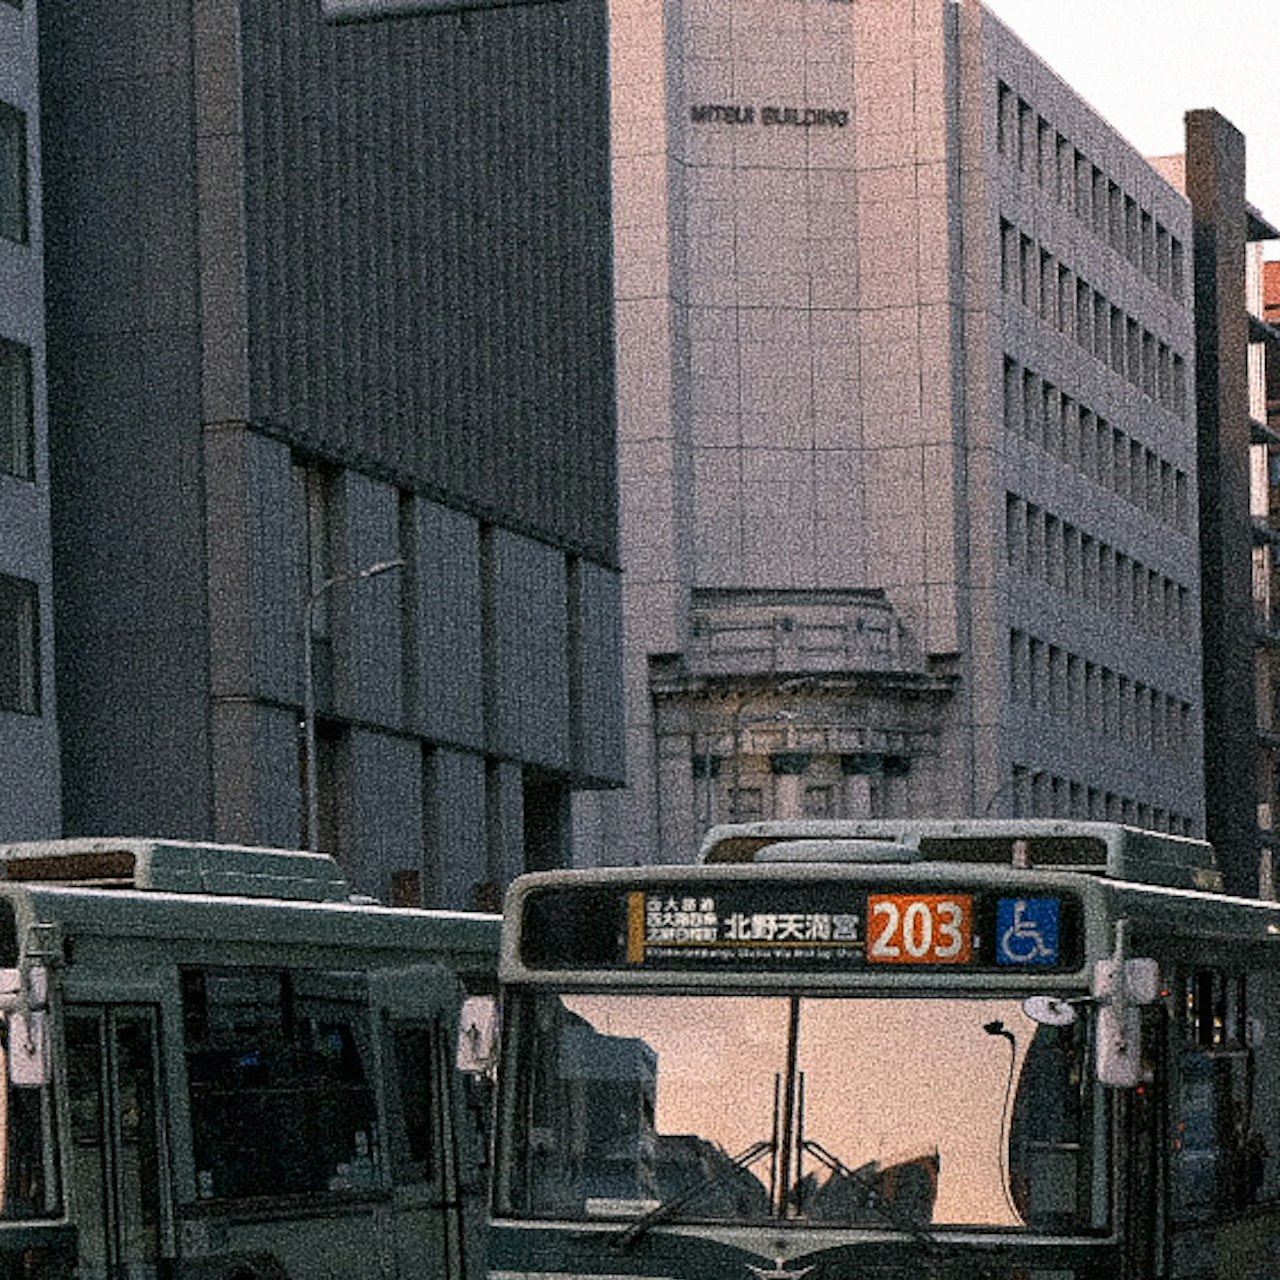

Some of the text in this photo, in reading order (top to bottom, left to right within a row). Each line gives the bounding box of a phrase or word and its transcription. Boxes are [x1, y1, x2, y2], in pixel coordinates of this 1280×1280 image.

[761, 107, 849, 127] BUILDING
[723, 913, 860, 941] 北野天満宮
[870, 900, 965, 958] 203
